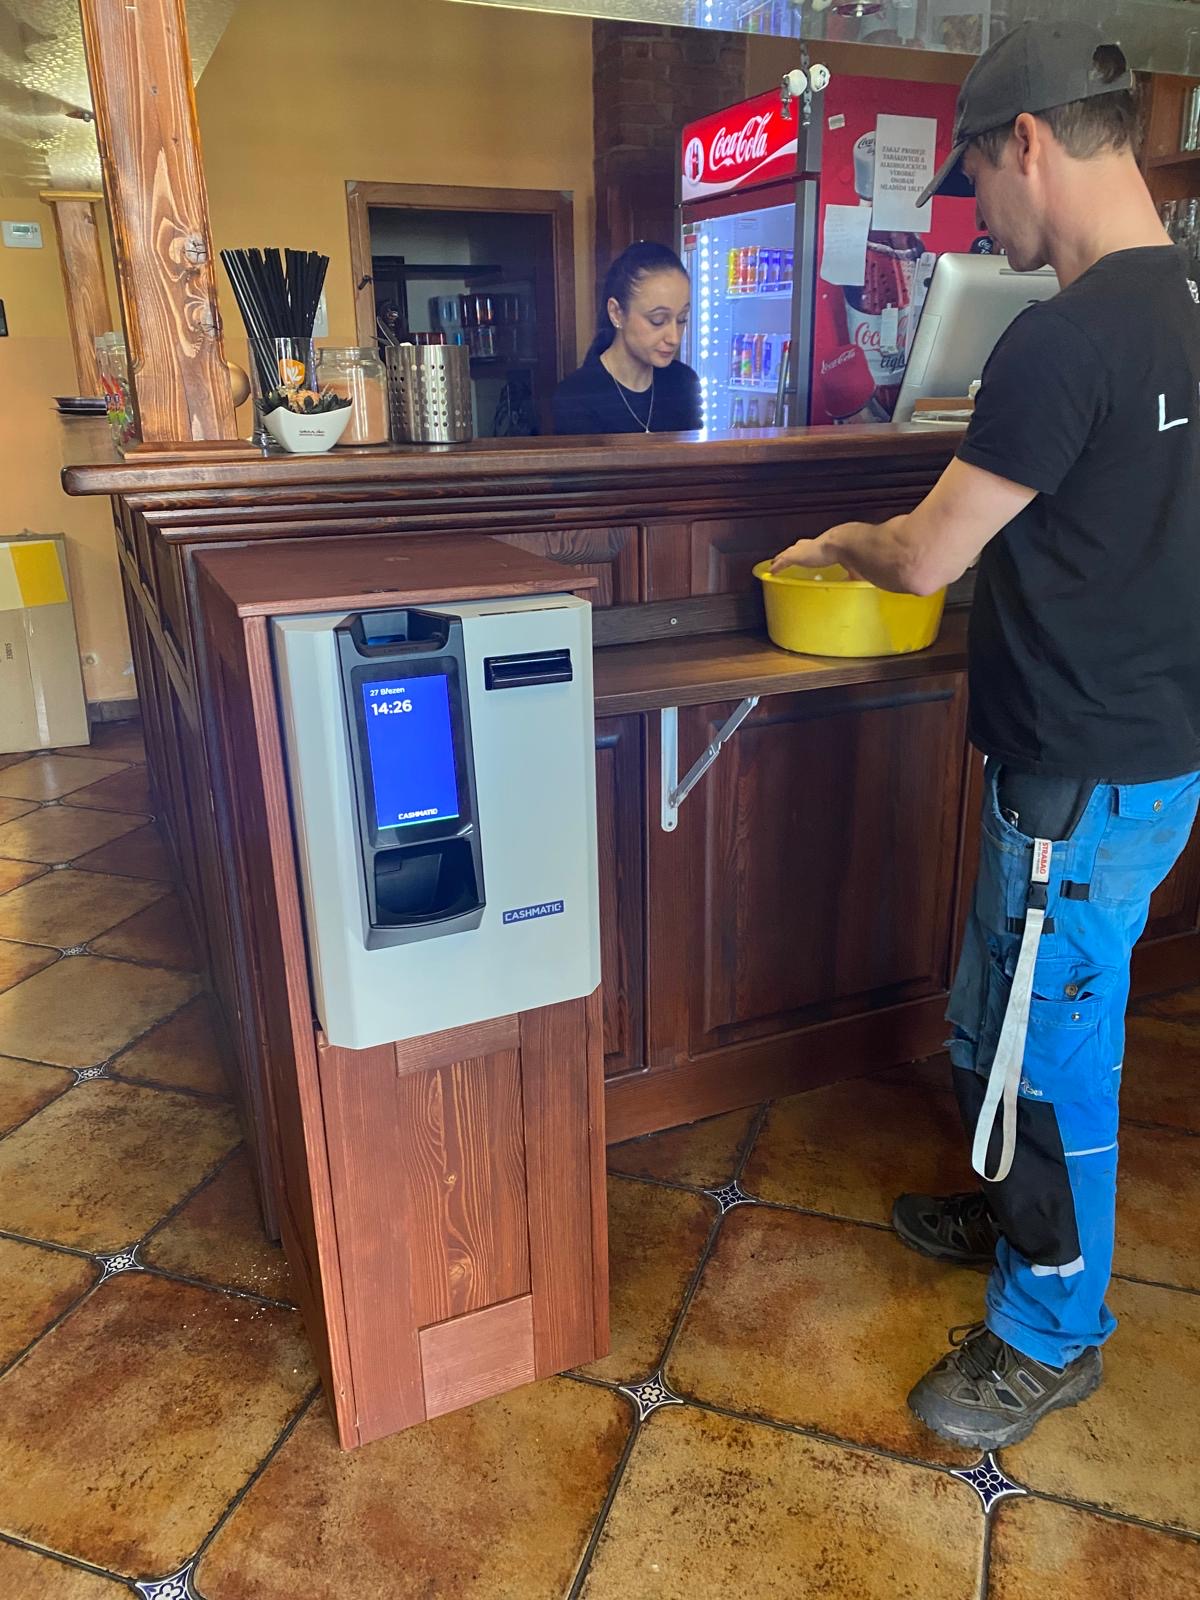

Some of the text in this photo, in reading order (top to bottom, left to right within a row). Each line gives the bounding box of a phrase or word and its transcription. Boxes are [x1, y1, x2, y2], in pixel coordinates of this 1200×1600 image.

[709, 112, 774, 171] Coca-Cola
[369, 689, 379, 697] 27
[371, 699, 413, 716] 14:26
[505, 902, 562, 922] CASHMATIC
